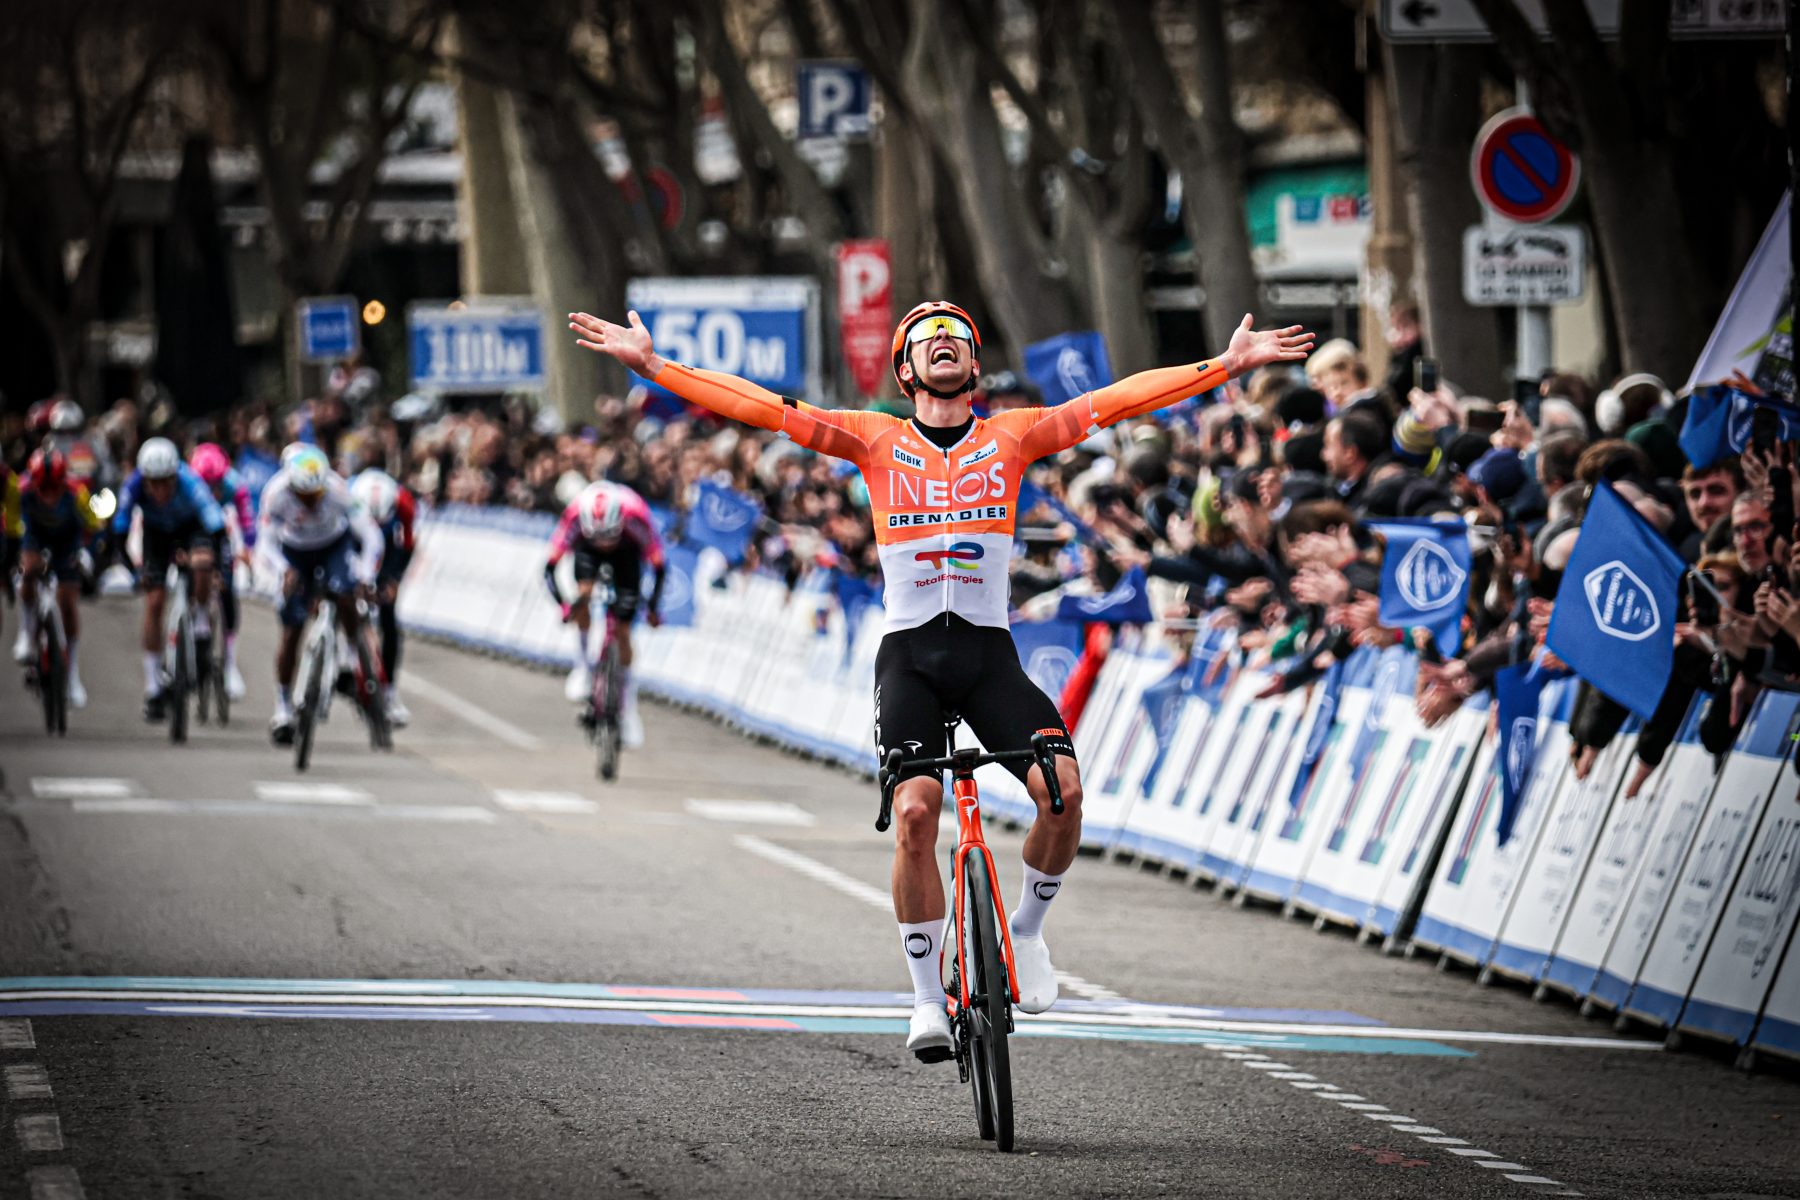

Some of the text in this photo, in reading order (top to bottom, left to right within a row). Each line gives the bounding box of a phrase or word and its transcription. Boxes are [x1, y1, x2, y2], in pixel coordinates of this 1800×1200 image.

[808, 68, 853, 129] P
[840, 253, 889, 315] P
[895, 449, 922, 468] GOBIK
[888, 461, 1006, 507] INEOS
[889, 507, 1006, 527] GRENADIER
[914, 573, 984, 588] TotalEnergies
